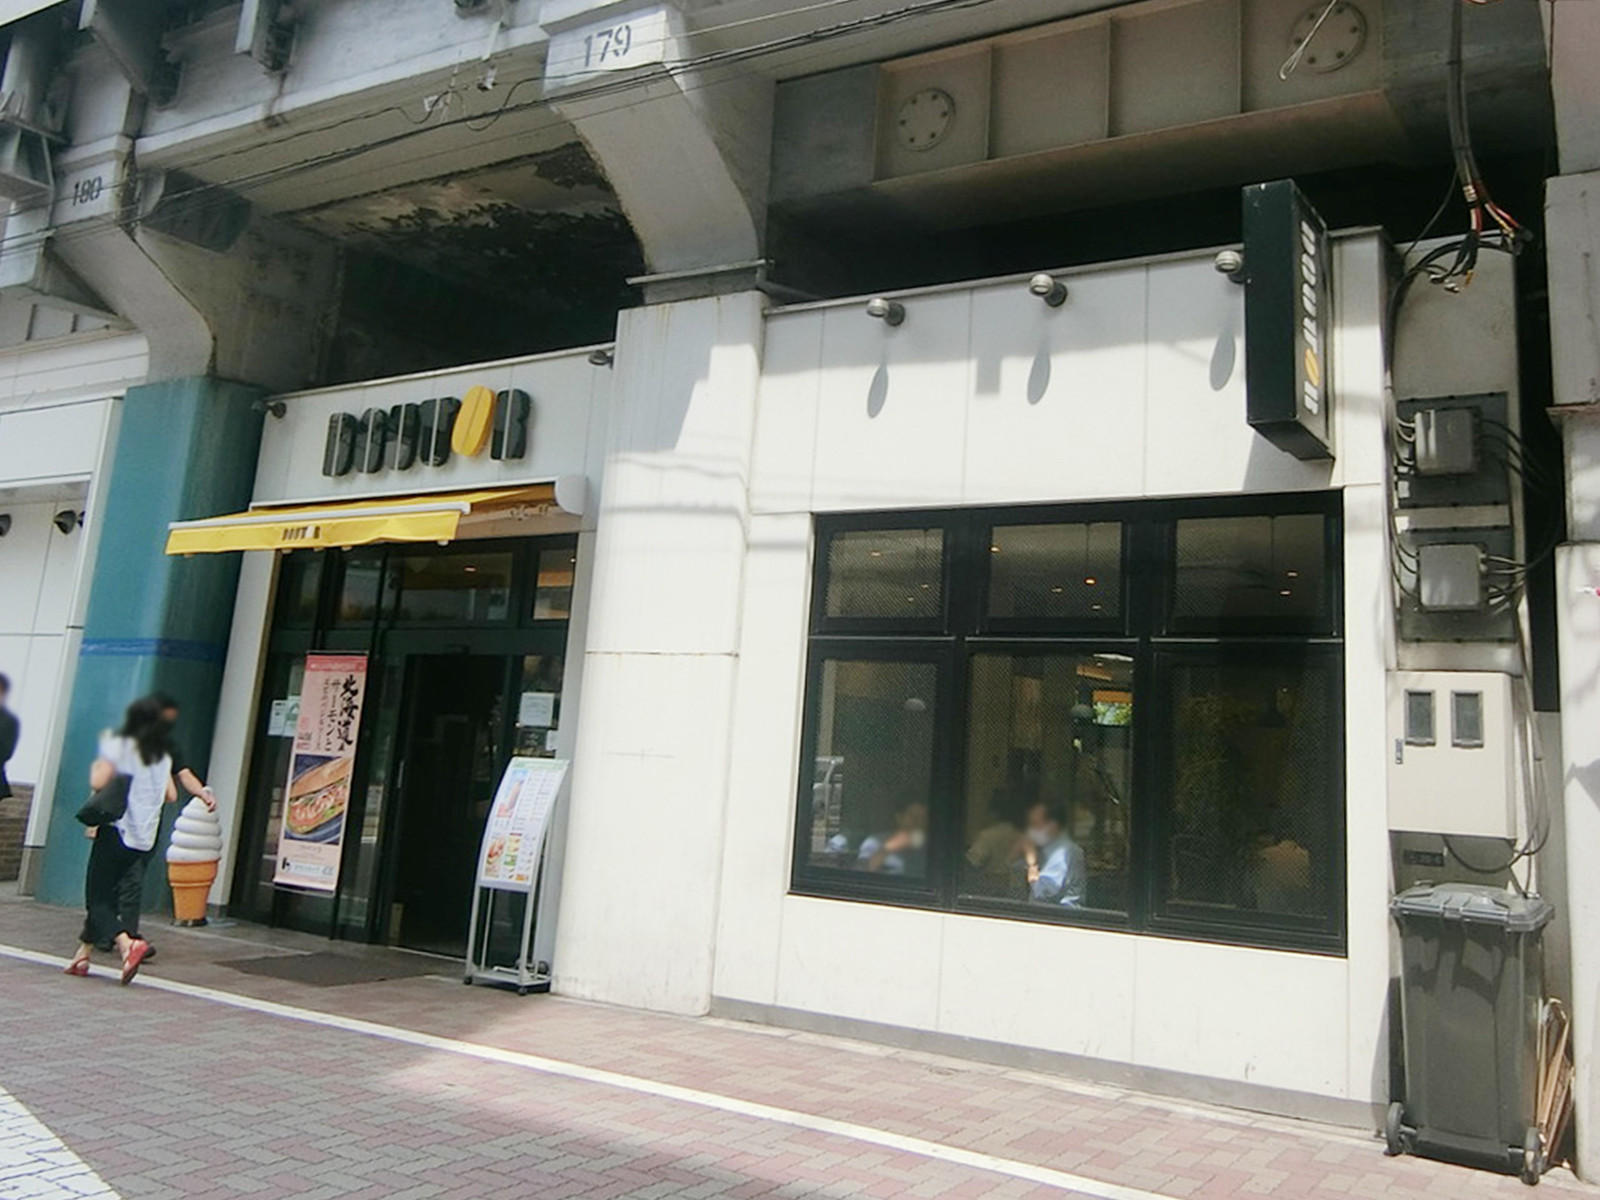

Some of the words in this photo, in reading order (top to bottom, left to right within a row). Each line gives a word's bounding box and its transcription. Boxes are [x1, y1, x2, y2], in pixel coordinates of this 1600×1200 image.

[584, 25, 631, 66] 179
[73, 176, 102, 206] 180
[322, 385, 531, 477] DOUTOR
